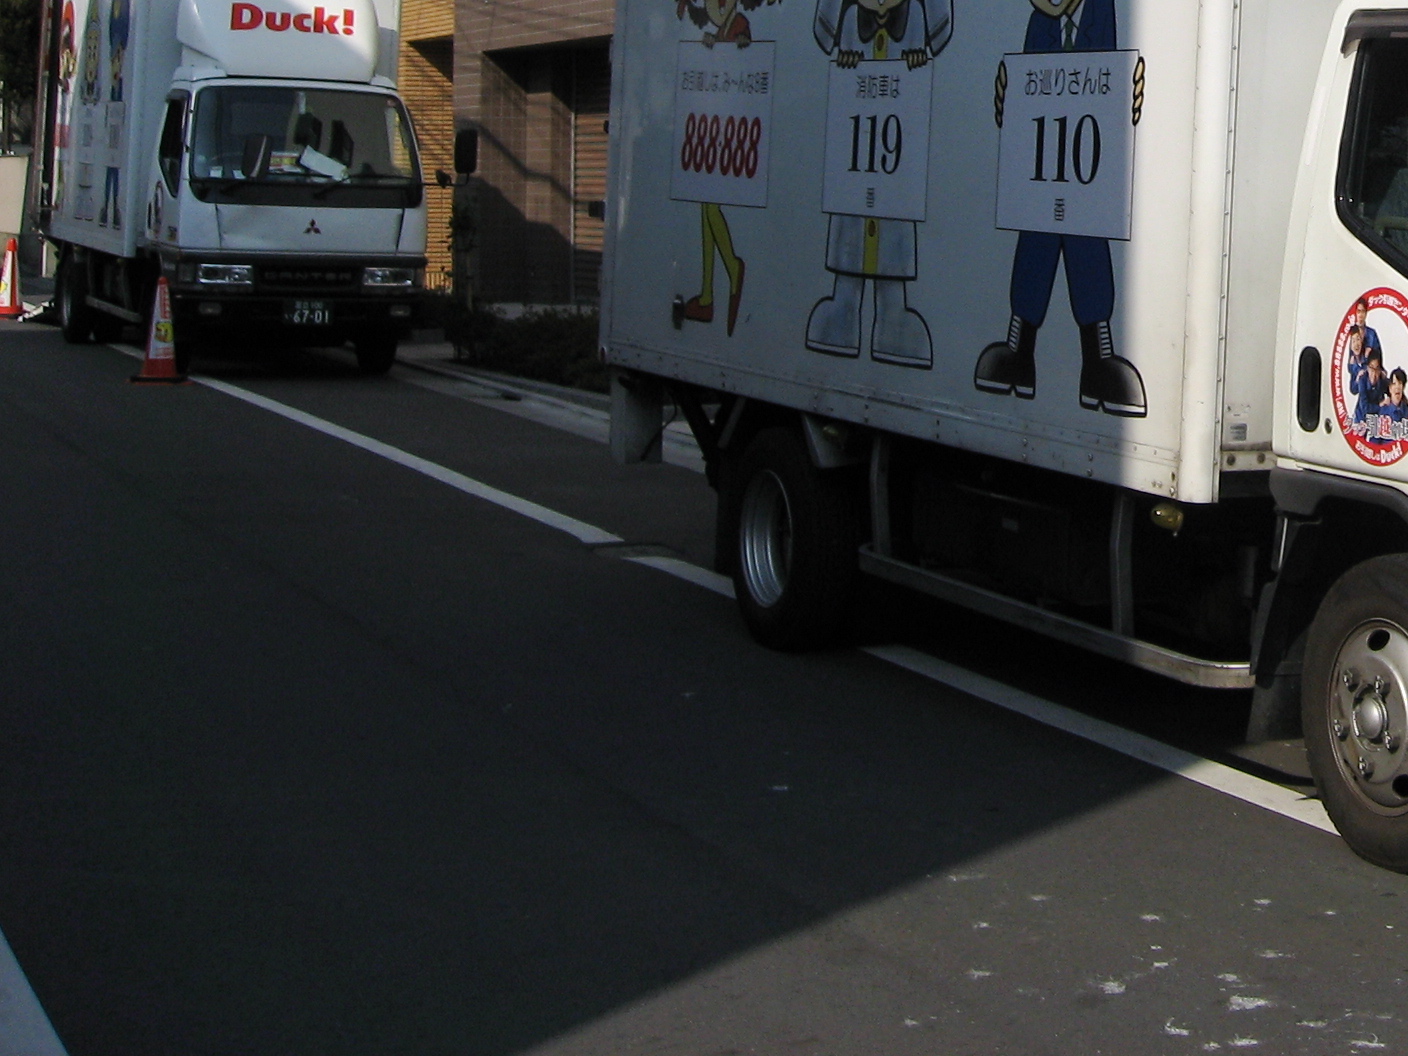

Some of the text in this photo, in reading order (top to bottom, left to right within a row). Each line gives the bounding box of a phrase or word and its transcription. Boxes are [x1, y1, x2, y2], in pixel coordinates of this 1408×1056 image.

[231, 2, 356, 36] Duck!
[1024, 67, 1112, 96] お巡りさんは
[848, 114, 902, 175] 119
[1030, 114, 1101, 185] 110
[293, 310, 328, 323] 67-01
